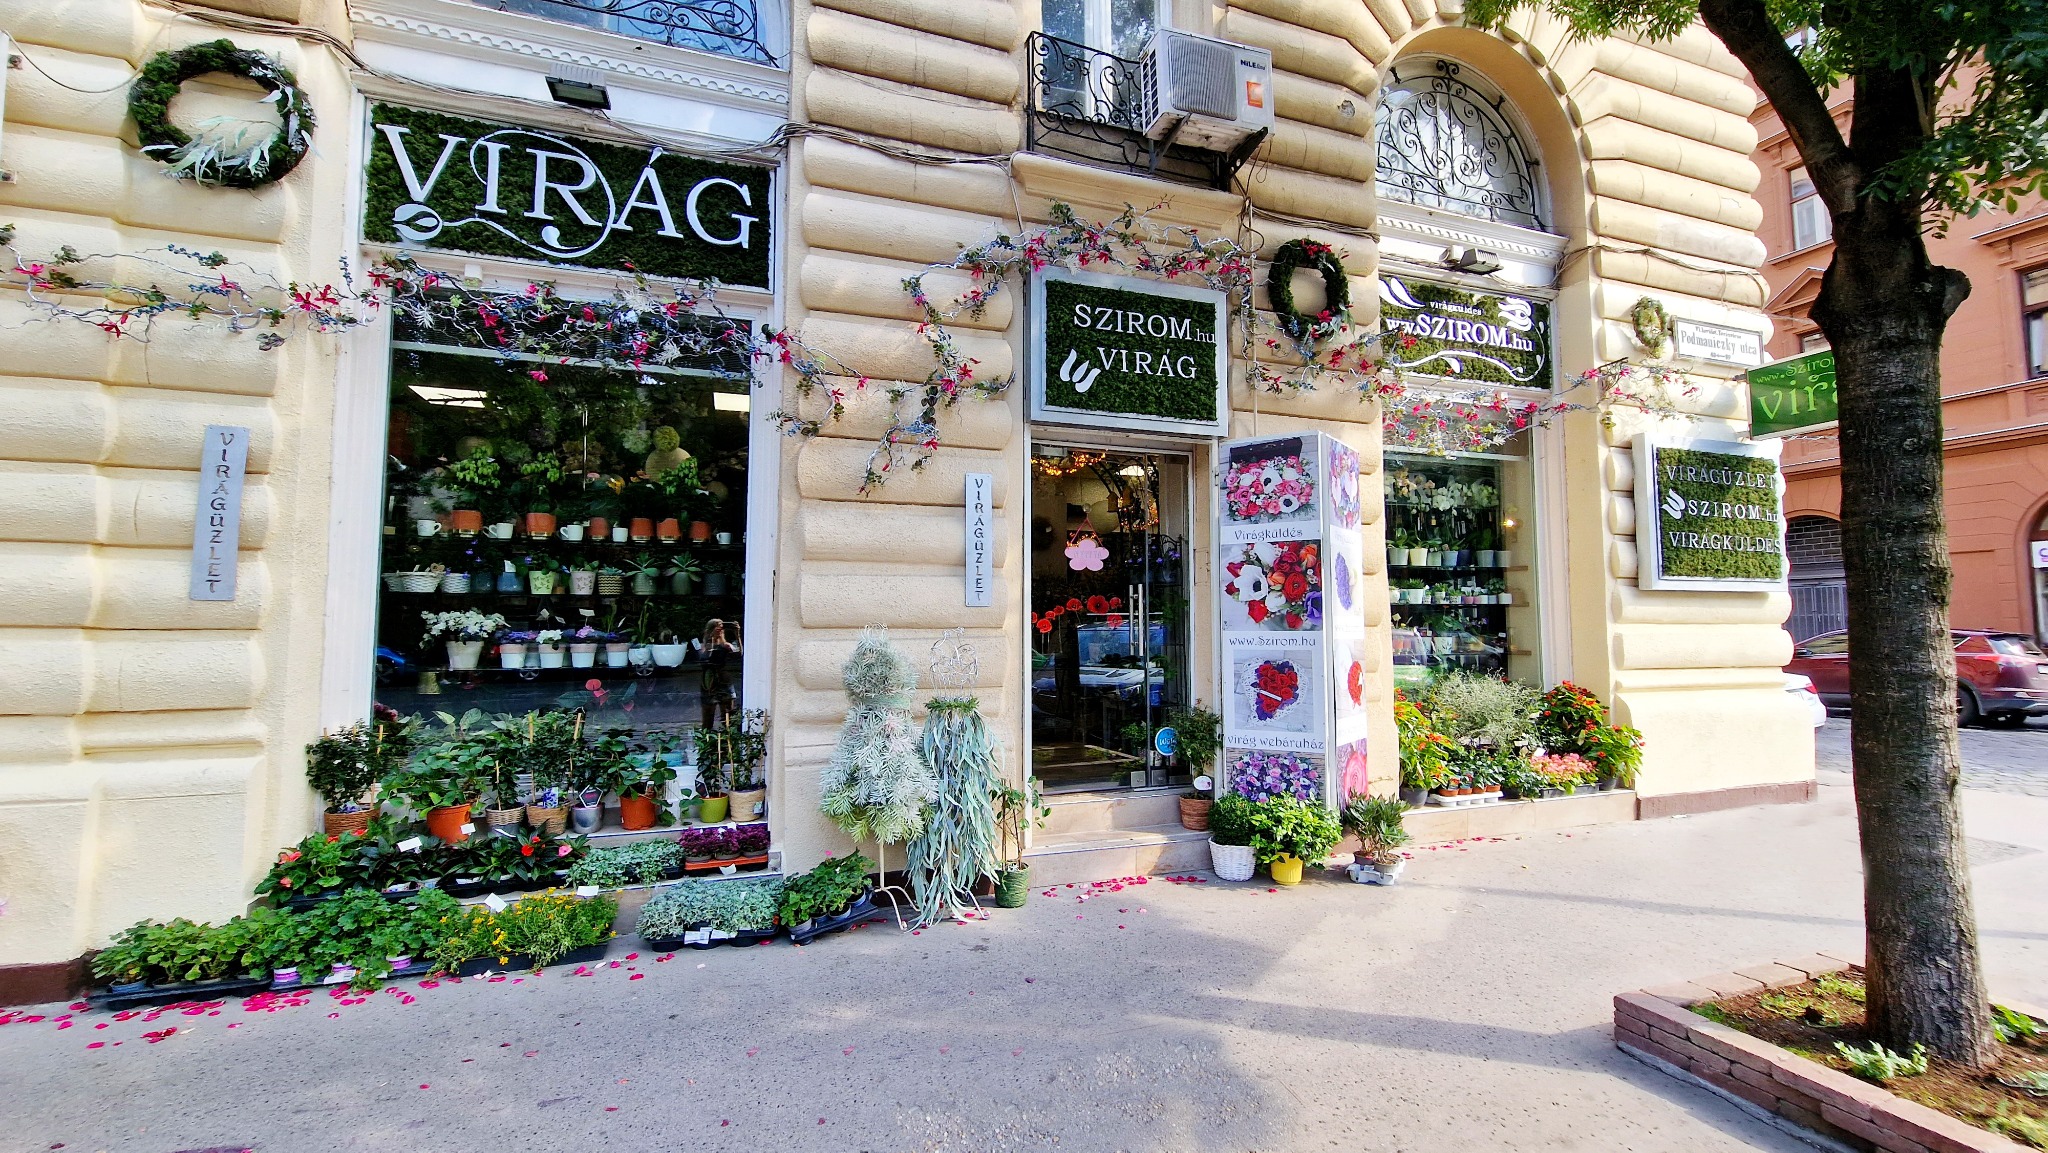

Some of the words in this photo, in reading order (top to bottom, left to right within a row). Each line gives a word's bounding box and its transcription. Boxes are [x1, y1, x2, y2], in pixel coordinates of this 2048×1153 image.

[376, 123, 760, 248] VIRÁG
[1073, 303, 1216, 344] SZIROM.hu
[1681, 330, 1736, 355] Podmaniczky
[1740, 342, 1757, 355] utca
[1097, 347, 1198, 380] VIRÁG
[1756, 356, 1836, 384] www.Sziro
[1757, 379, 1838, 420] vir
[1666, 463, 1778, 490] VIRÁGÜZLET
[205, 432, 235, 594] VIRÁGÜZLET
[1688, 498, 1779, 523] SZIROM.hu
[974, 477, 985, 601] VIRÁGÜZLET
[1234, 526, 1304, 542] Virágküldés
[1229, 635, 1317, 647] www.Szirom.hu
[1227, 734, 1257, 748] virág
[1260, 736, 1325, 749] webáruház
